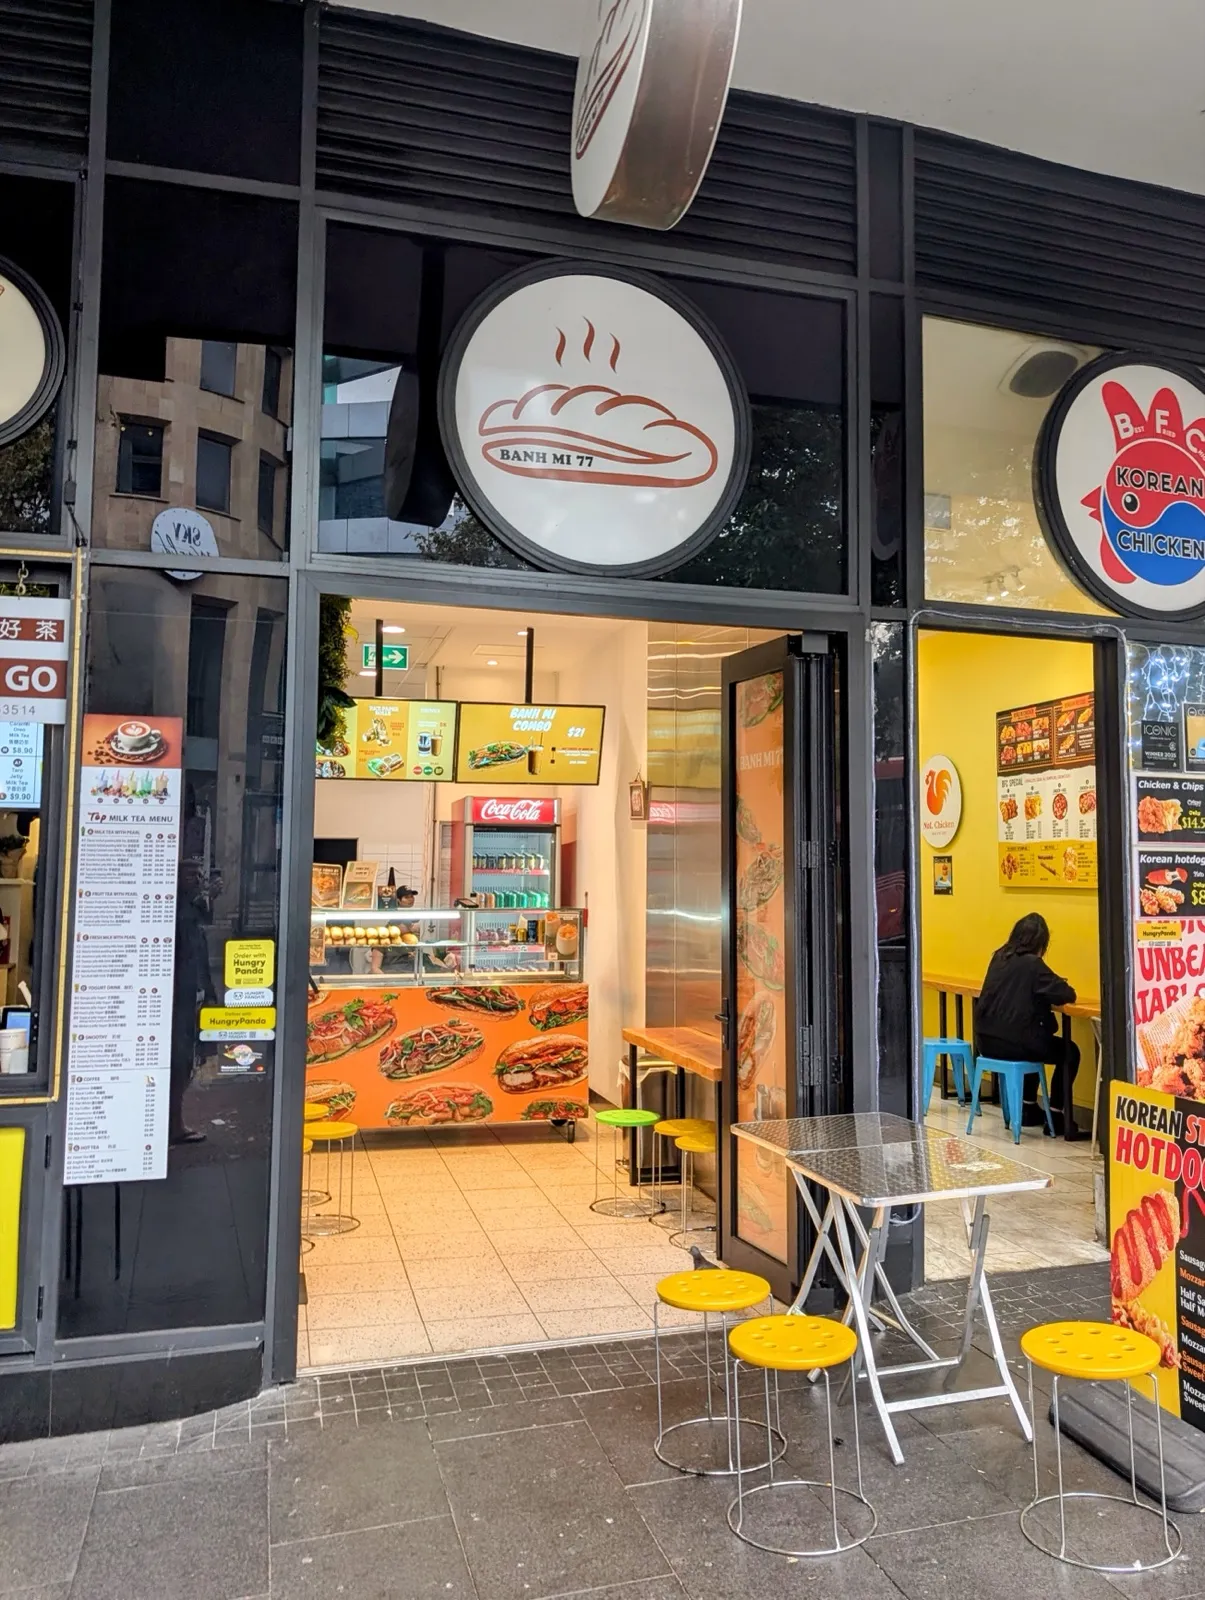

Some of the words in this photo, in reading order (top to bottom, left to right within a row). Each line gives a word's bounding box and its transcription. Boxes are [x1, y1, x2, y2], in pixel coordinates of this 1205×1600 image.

[500, 449, 547, 463] BANH
[552, 453, 571, 465] MI
[576, 455, 593, 467] 77
[1116, 466, 1205, 499] KOREAN
[1117, 529, 1205, 560] CHICKEN
[5, 665, 57, 692] GO
[0, 704, 36, 715] 3514
[513, 720, 552, 732] COMBO
[567, 726, 585, 738] $21
[1144, 725, 1177, 737] ICONIC
[1139, 780, 1171, 790] Chicken
[1173, 782, 1180, 790] &
[1182, 782, 1204, 792] Chips
[481, 799, 544, 820] Coca-Cola
[88, 812, 106, 823] Top
[1140, 854, 1172, 864] Korean
[234, 959, 265, 968] Hungry
[210, 1018, 266, 1026] HungryPanda
[1115, 1095, 1183, 1139] KOREAN
[1115, 1126, 1205, 1190] HOTDO
[1180, 1250, 1205, 1272] Sausag
[1180, 1286, 1196, 1301] Half
[1180, 1297, 1196, 1313] Half
[1197, 1305, 1205, 1318] M
